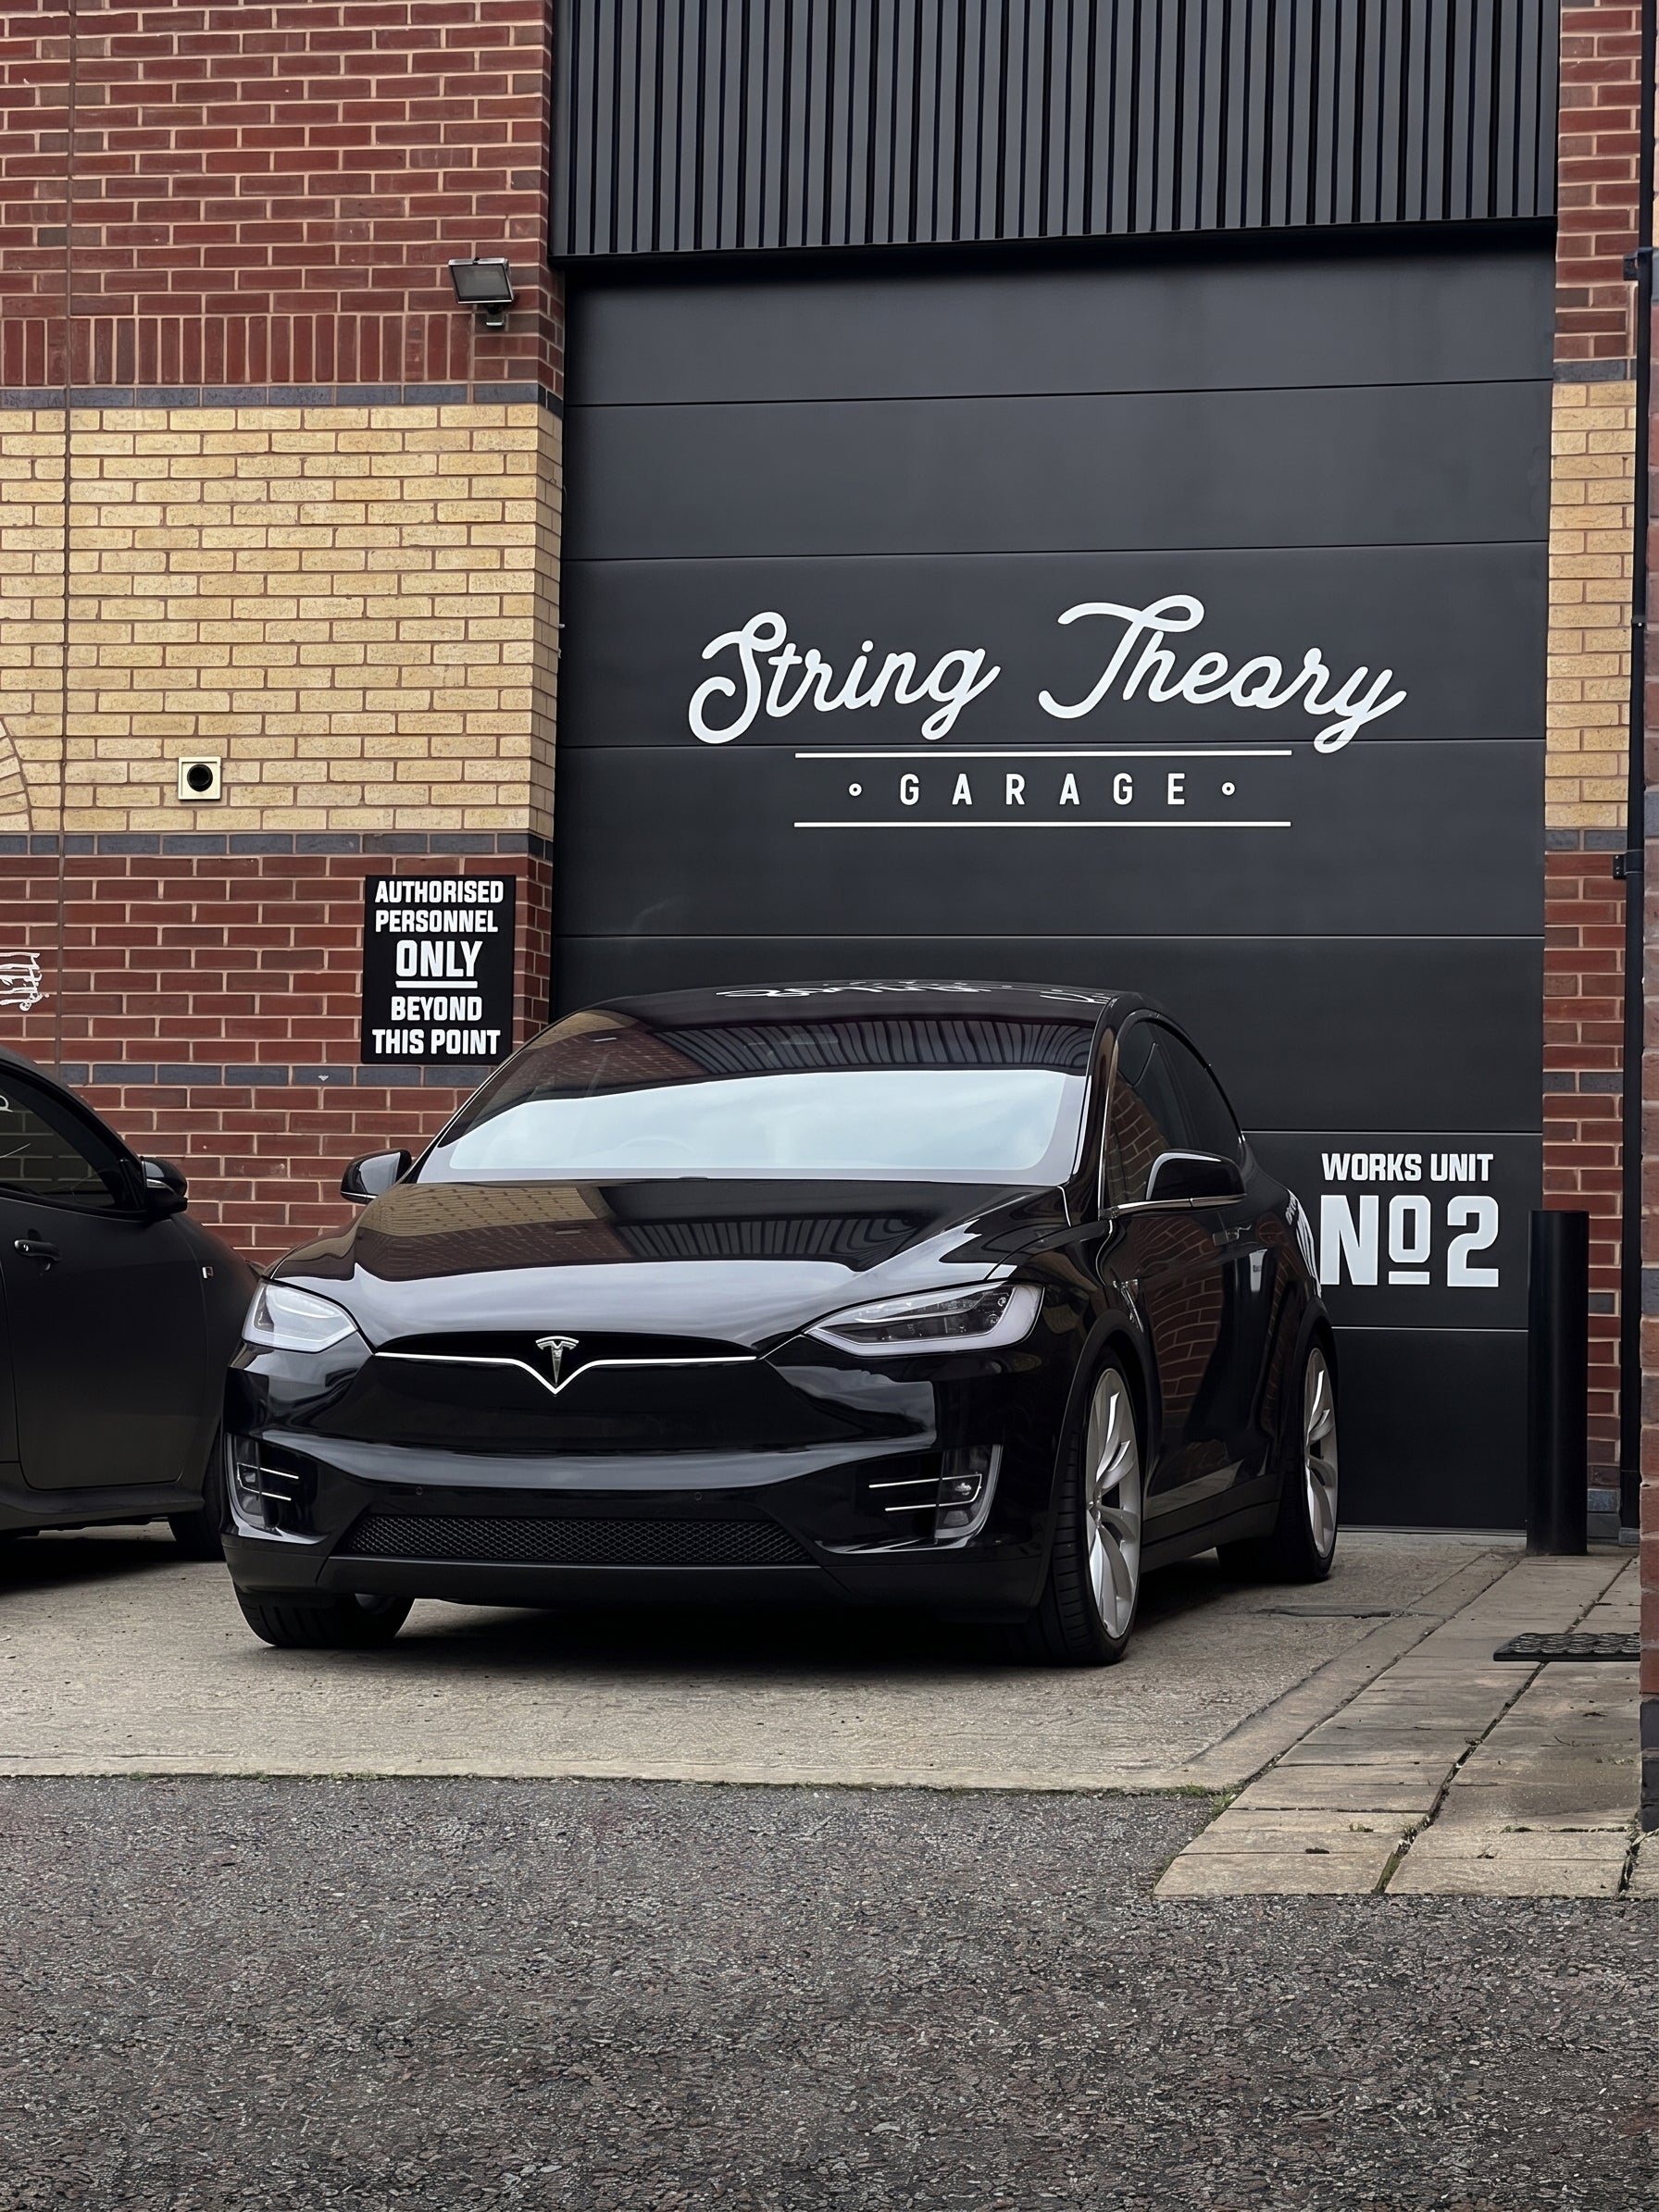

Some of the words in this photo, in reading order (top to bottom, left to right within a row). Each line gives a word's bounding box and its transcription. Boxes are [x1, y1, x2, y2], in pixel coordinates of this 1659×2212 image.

[689, 612, 1002, 743] String
[1039, 595, 1407, 753] Theory
[900, 773, 1185, 805] GARAGE
[374, 880, 504, 903] AUTHORISED
[375, 910, 499, 933] PERSONNEL
[395, 940, 483, 977] ONLY
[391, 996, 482, 1021] BEYOND
[371, 1028, 425, 1054] THIS
[430, 1028, 501, 1055] POINT
[1321, 1153, 1422, 1182] WORKS
[1430, 1153, 1494, 1182] UNIT
